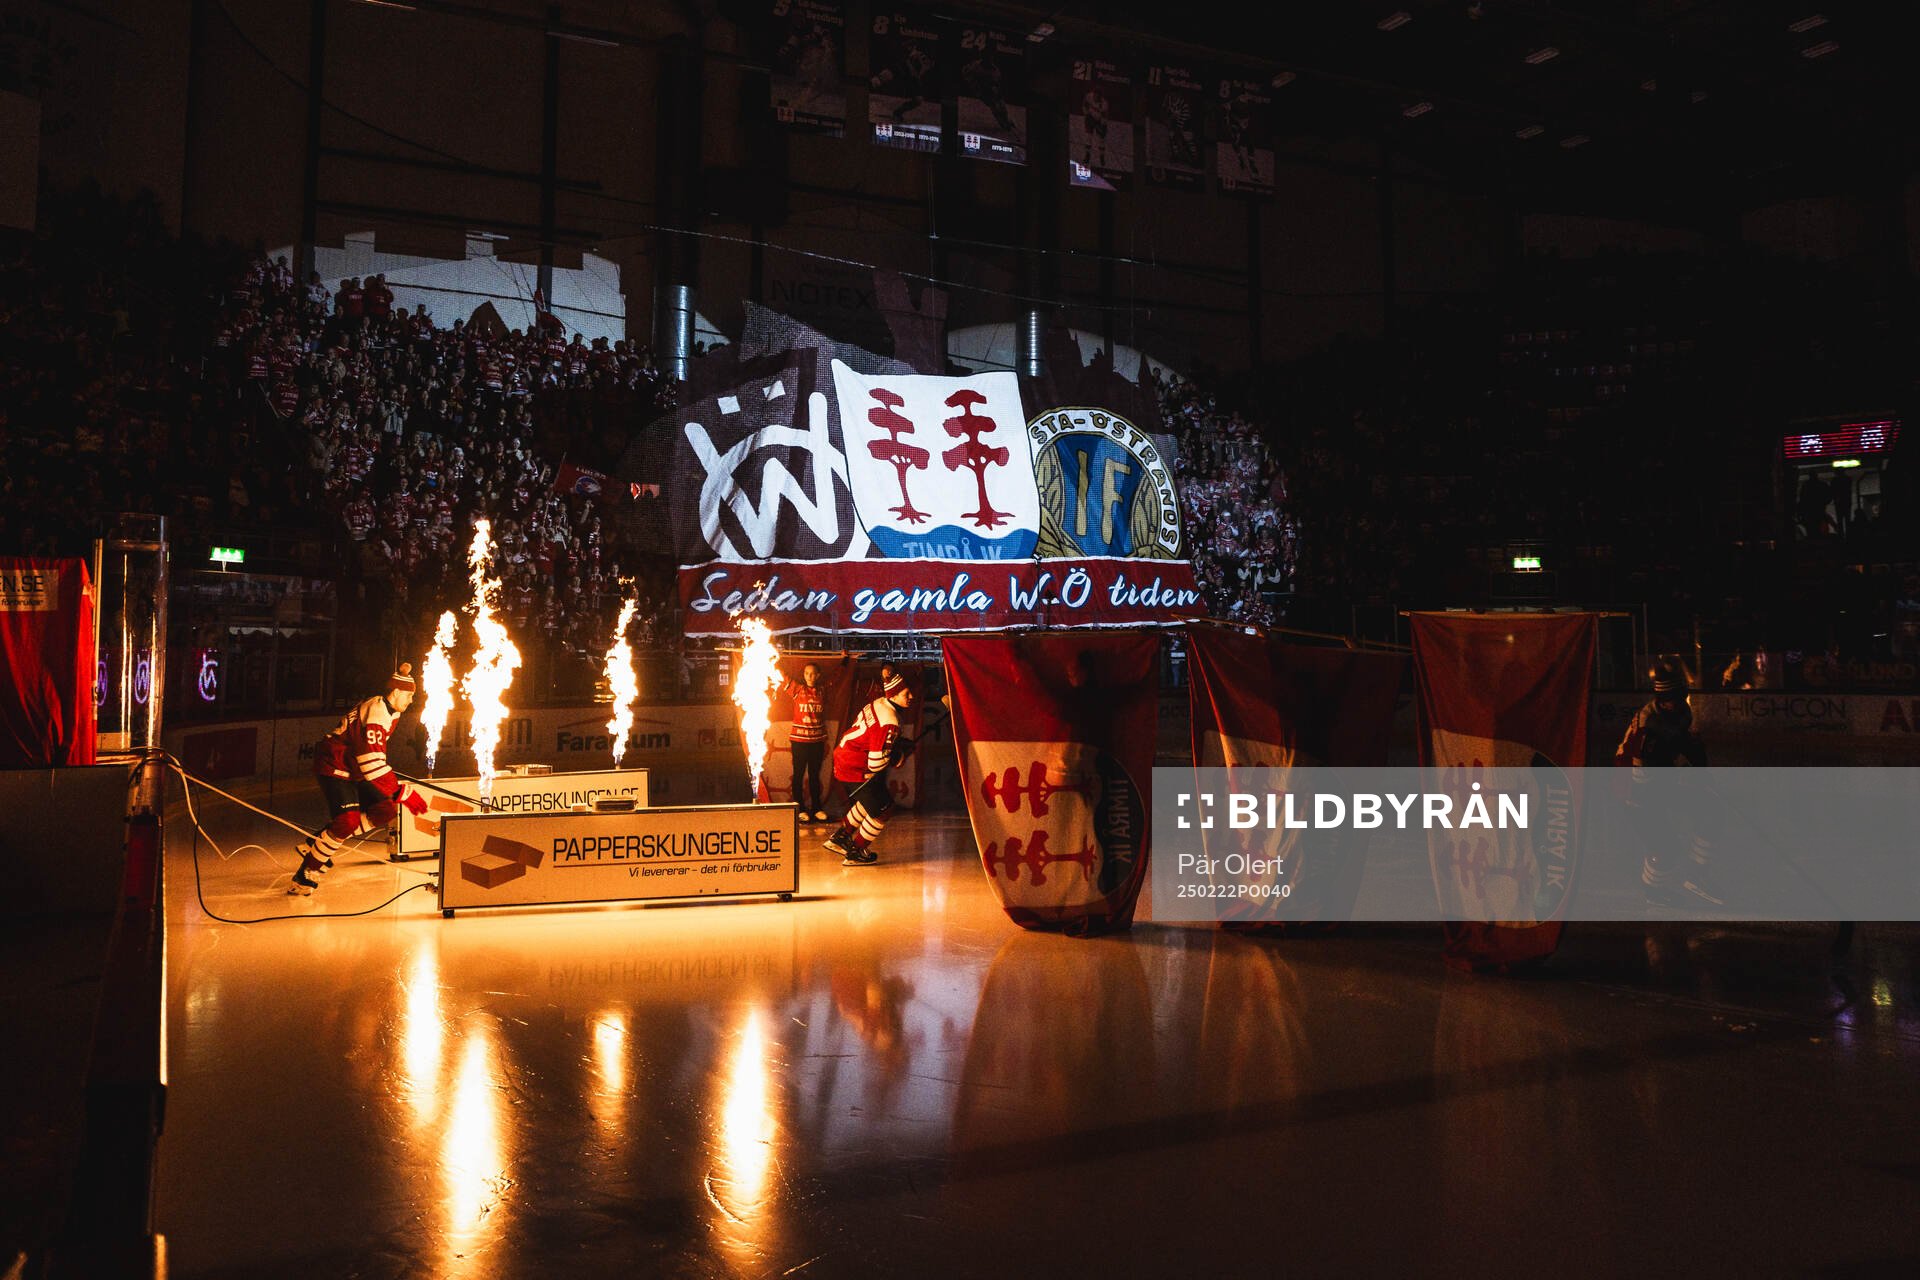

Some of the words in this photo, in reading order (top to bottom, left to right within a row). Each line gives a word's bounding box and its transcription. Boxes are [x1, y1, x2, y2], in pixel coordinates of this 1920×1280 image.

[960, 29, 987, 50] 24
[1072, 61, 1092, 80] 21
[1076, 450, 1131, 545] IF
[690, 569, 838, 612] Sedan
[850, 571, 994, 624] gamla
[1108, 573, 1200, 609] tiden
[1727, 698, 1846, 718] HIGHCON
[367, 730, 384, 745] 92
[552, 829, 782, 862] PAPPERSKUNGEN.SE
[629, 867, 640, 877] Vi
[642, 866, 690, 877] levererar
[700, 863, 719, 874] det
[721, 863, 731, 873] ni
[732, 860, 782, 873] förbrukar
